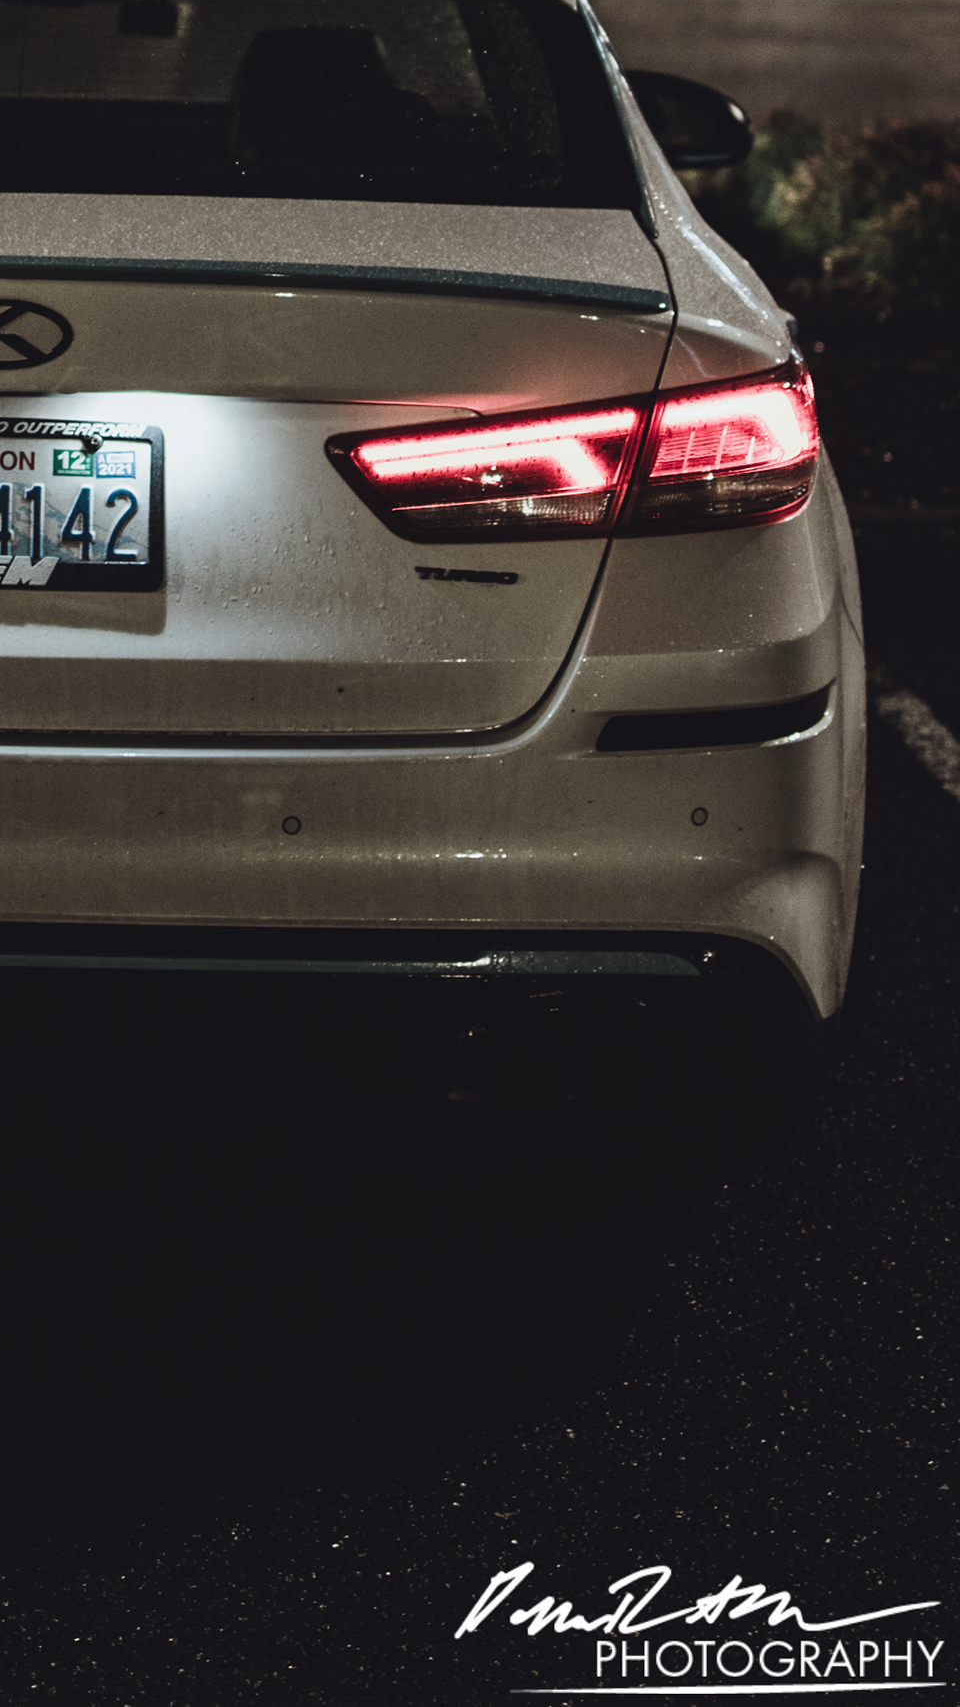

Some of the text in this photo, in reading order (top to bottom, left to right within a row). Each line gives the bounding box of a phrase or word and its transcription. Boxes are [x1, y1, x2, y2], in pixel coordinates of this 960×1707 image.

[13, 421, 146, 437] OUTPERFORM
[57, 451, 86, 469] 12
[98, 463, 132, 476] 2021
